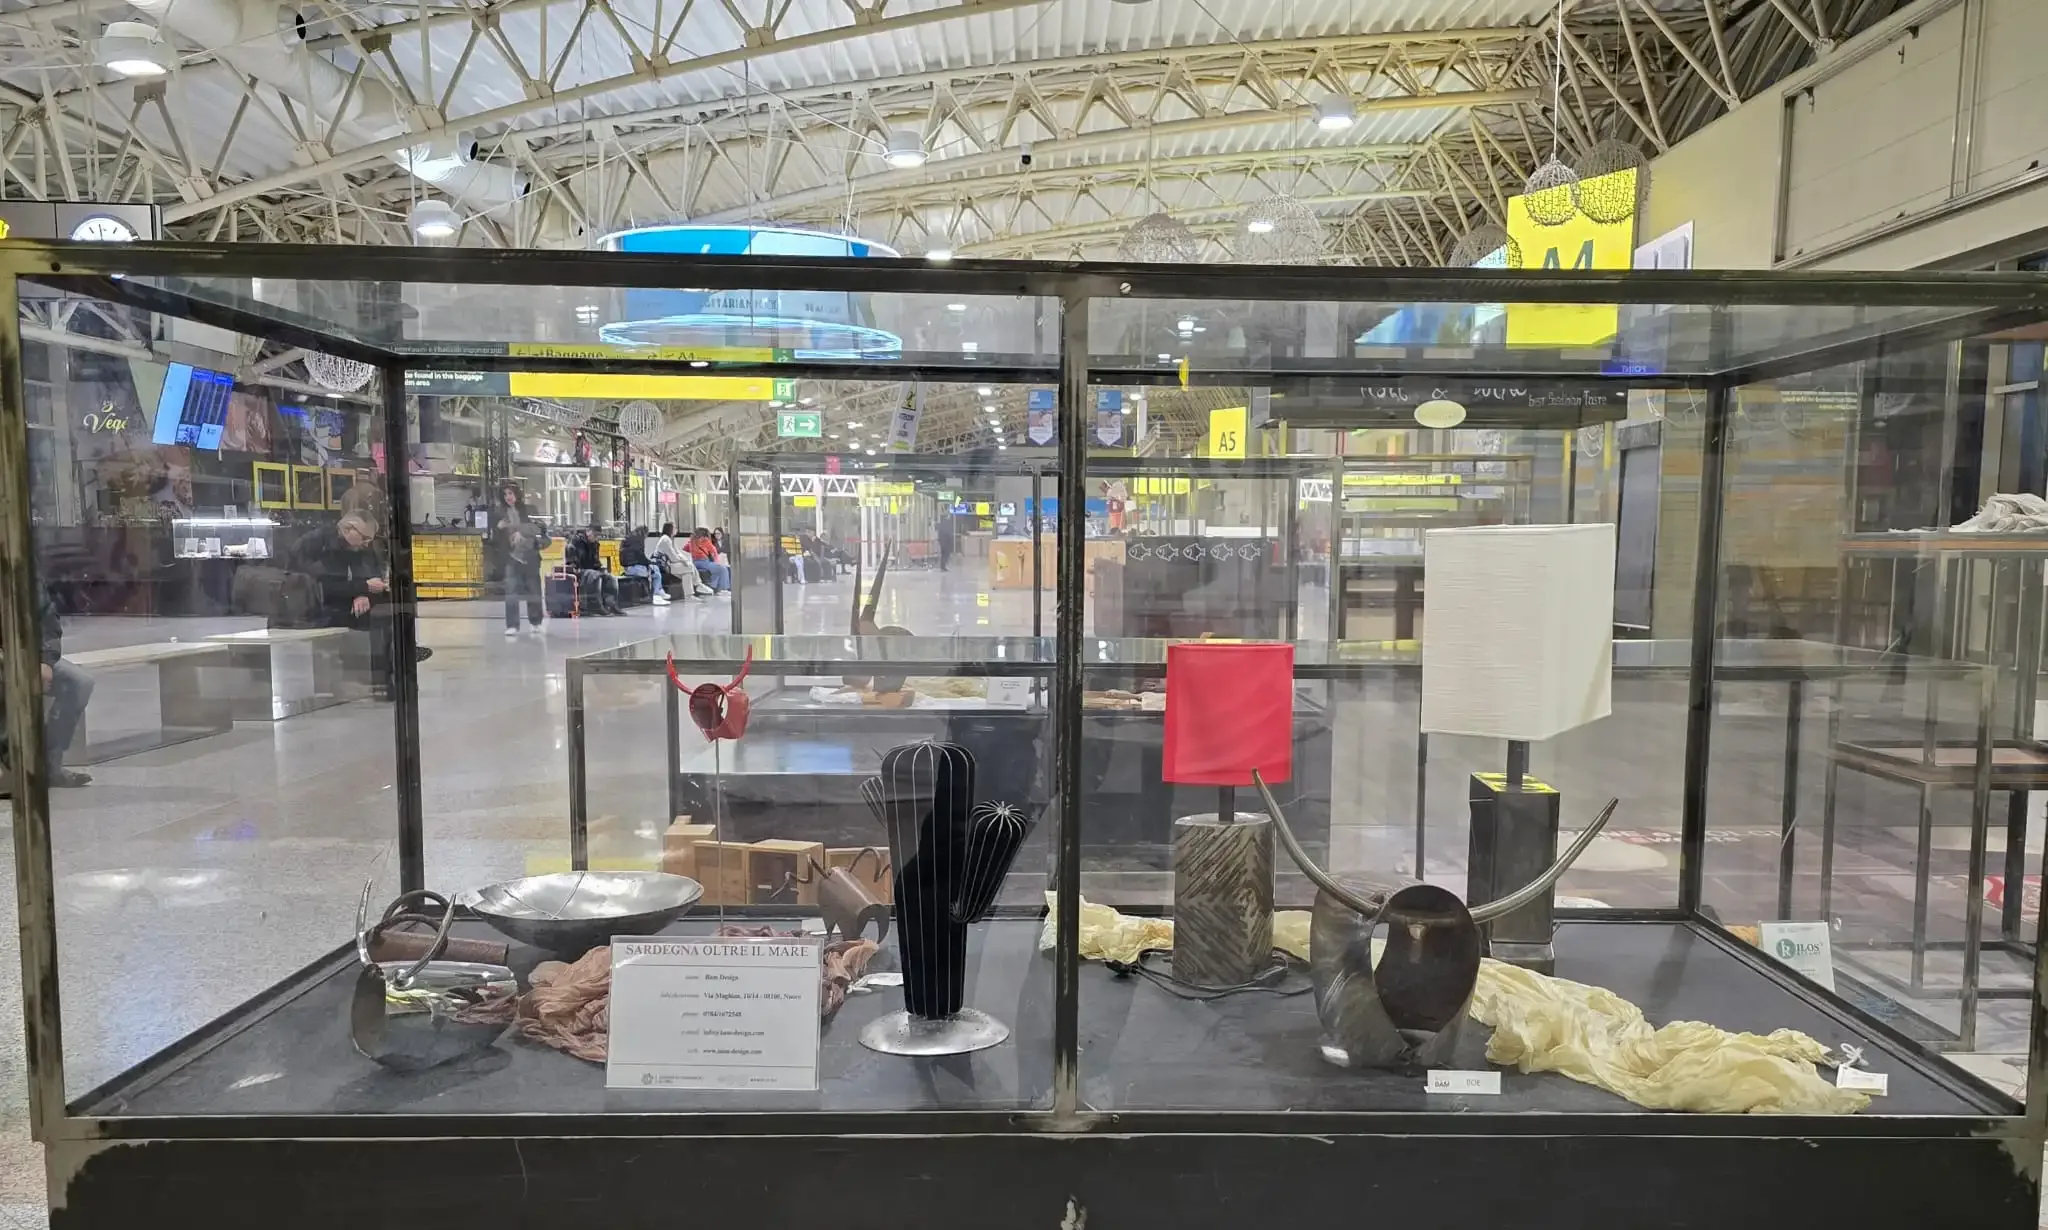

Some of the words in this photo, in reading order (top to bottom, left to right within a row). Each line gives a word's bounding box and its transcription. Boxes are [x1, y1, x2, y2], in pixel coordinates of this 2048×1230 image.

[414, 371, 433, 379] found
[434, 371, 441, 379] in
[442, 372, 453, 380] the
[454, 372, 483, 382] baggage
[1218, 431, 1236, 452] A5
[626, 944, 700, 956] SARDEGNA
[702, 945, 749, 956] OLTRE
[751, 945, 765, 956] IL
[768, 946, 809, 957] MARE
[703, 991, 714, 999] Via
